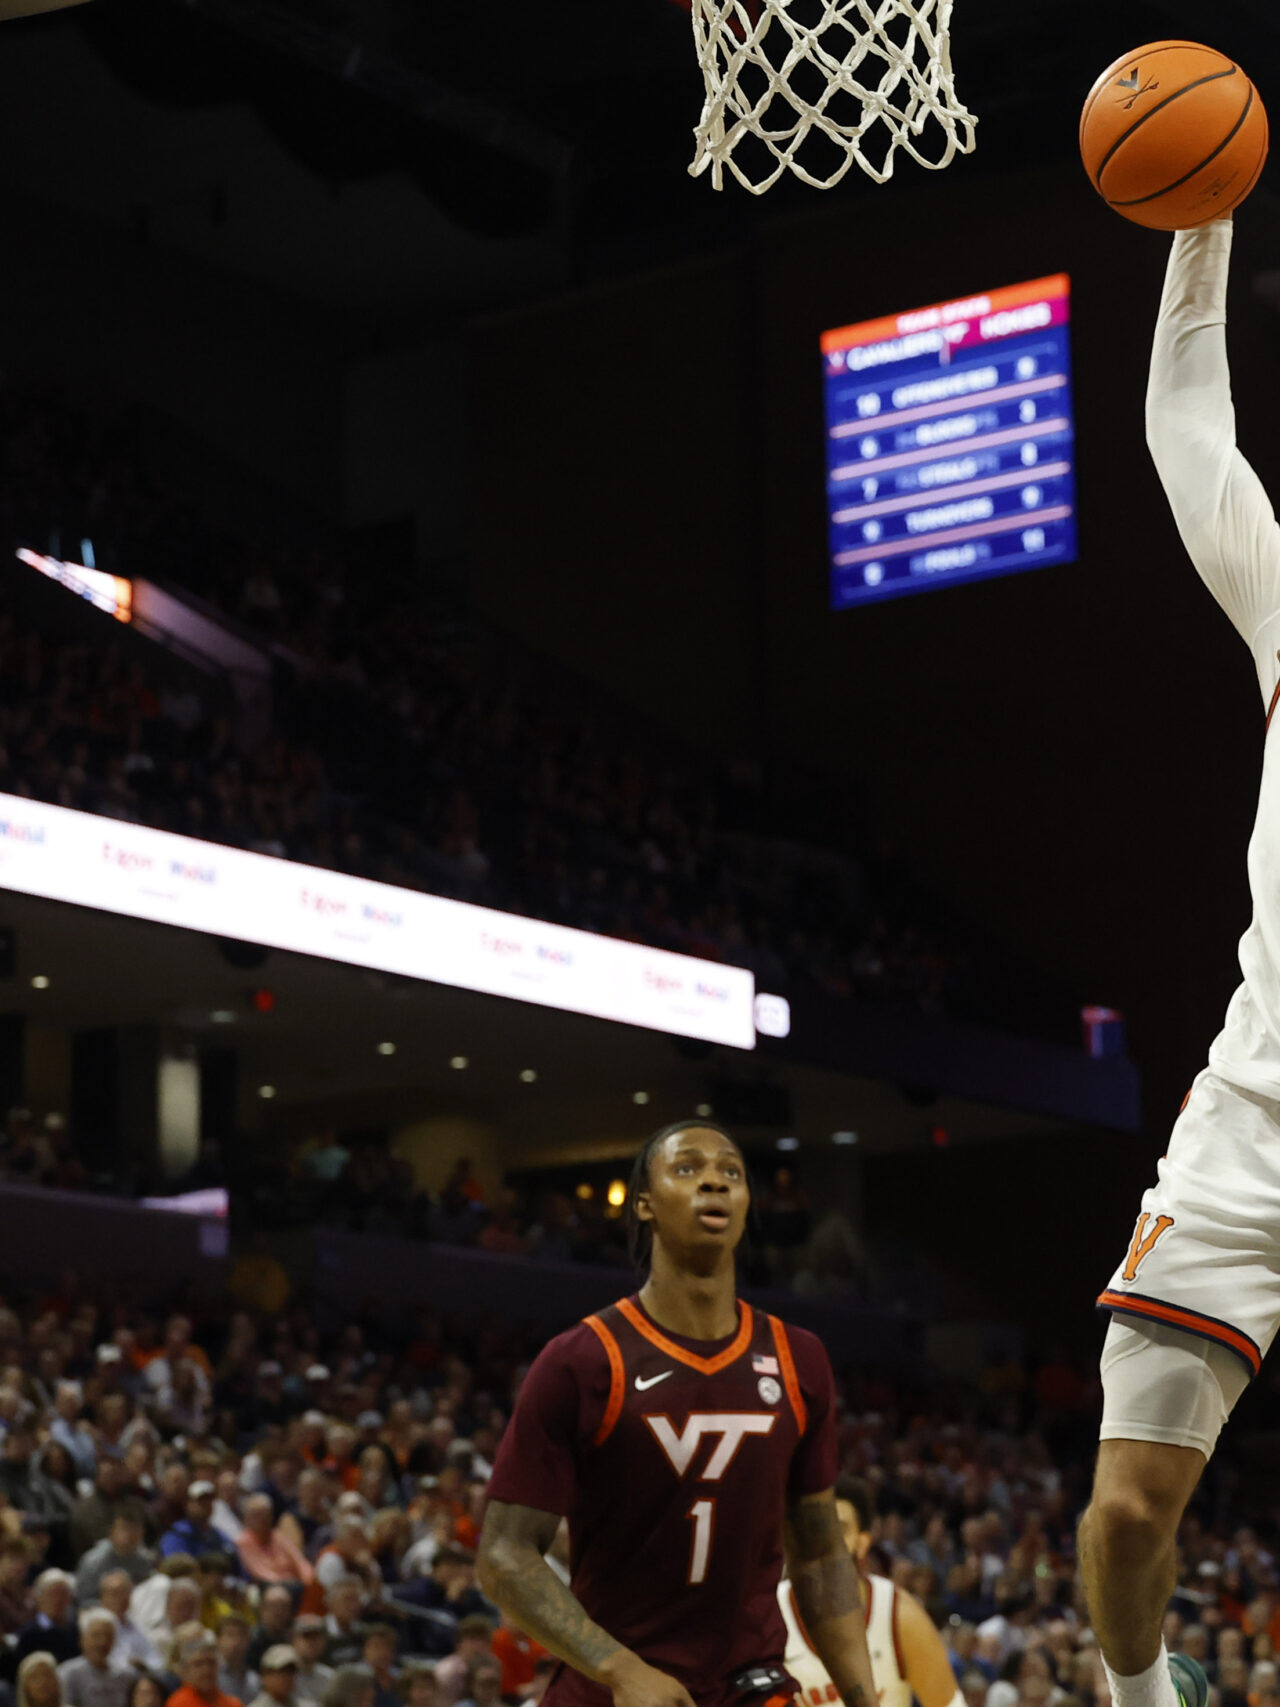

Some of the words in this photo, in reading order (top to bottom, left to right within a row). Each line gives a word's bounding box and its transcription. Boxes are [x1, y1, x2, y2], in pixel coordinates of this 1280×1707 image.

[1122, 1212, 1175, 1281] V
[641, 1410, 780, 1482] VT
[685, 1497, 717, 1587] 1
